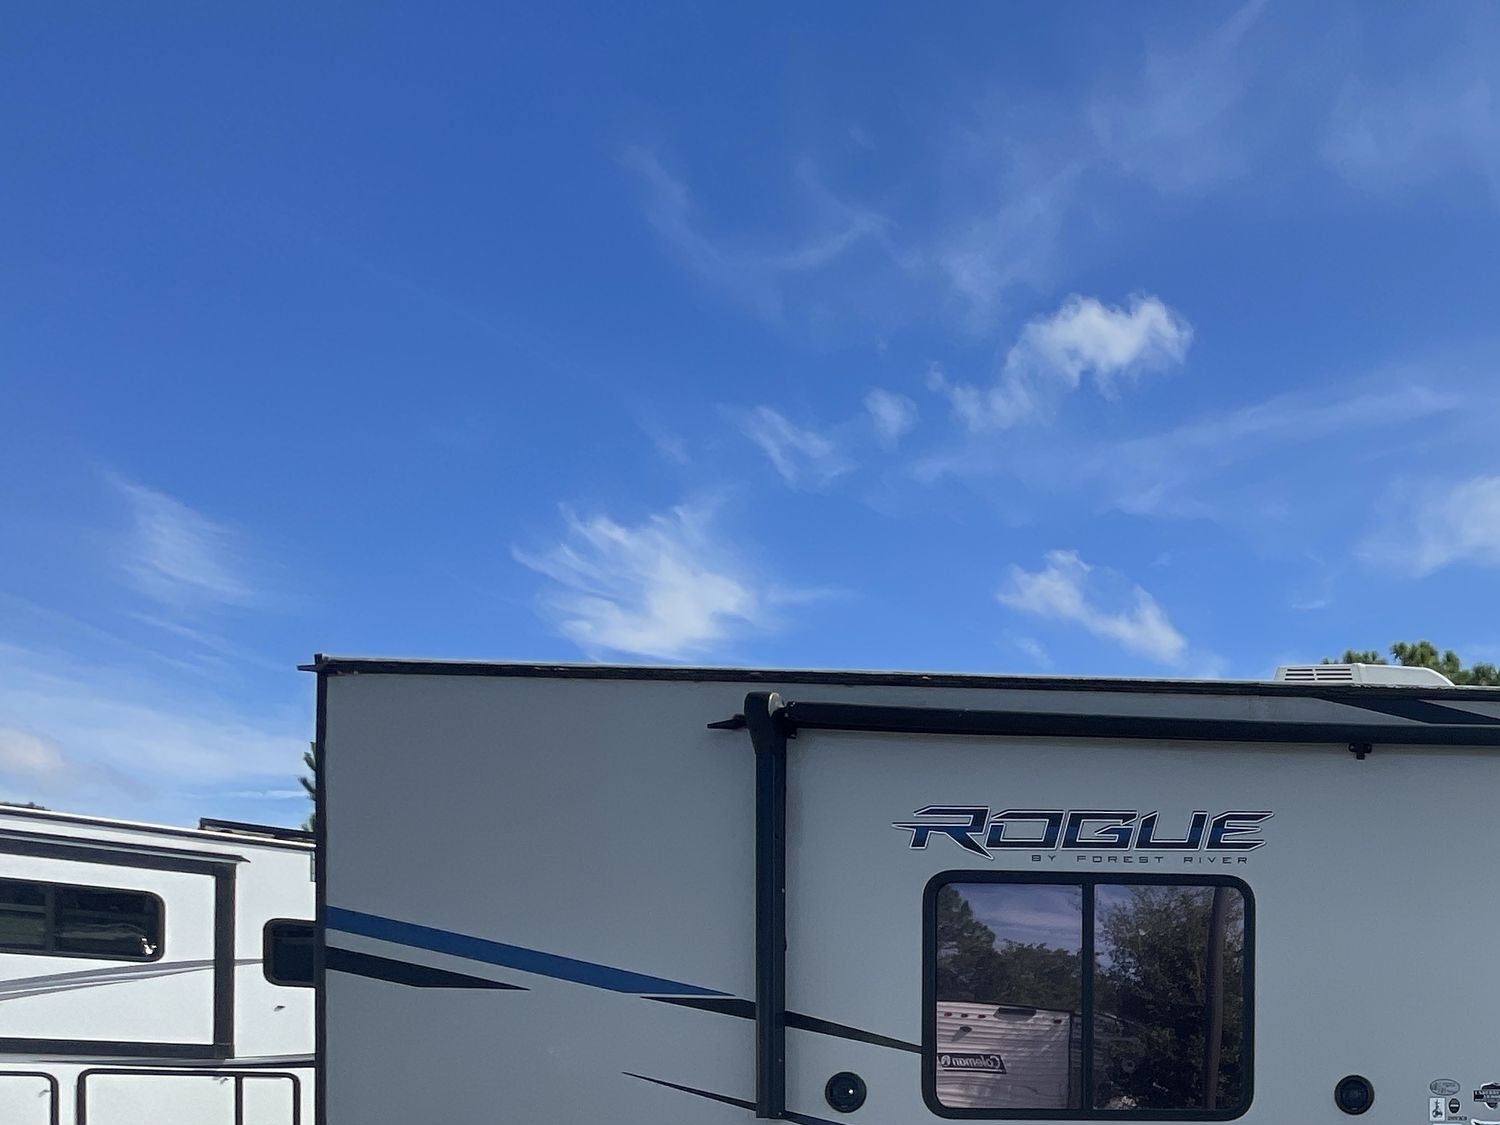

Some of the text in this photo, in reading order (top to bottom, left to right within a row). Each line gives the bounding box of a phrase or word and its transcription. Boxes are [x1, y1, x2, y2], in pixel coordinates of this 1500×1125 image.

[891, 804, 1274, 860] ROGUE
[1031, 853, 1249, 865] BY FOREST RIVER
